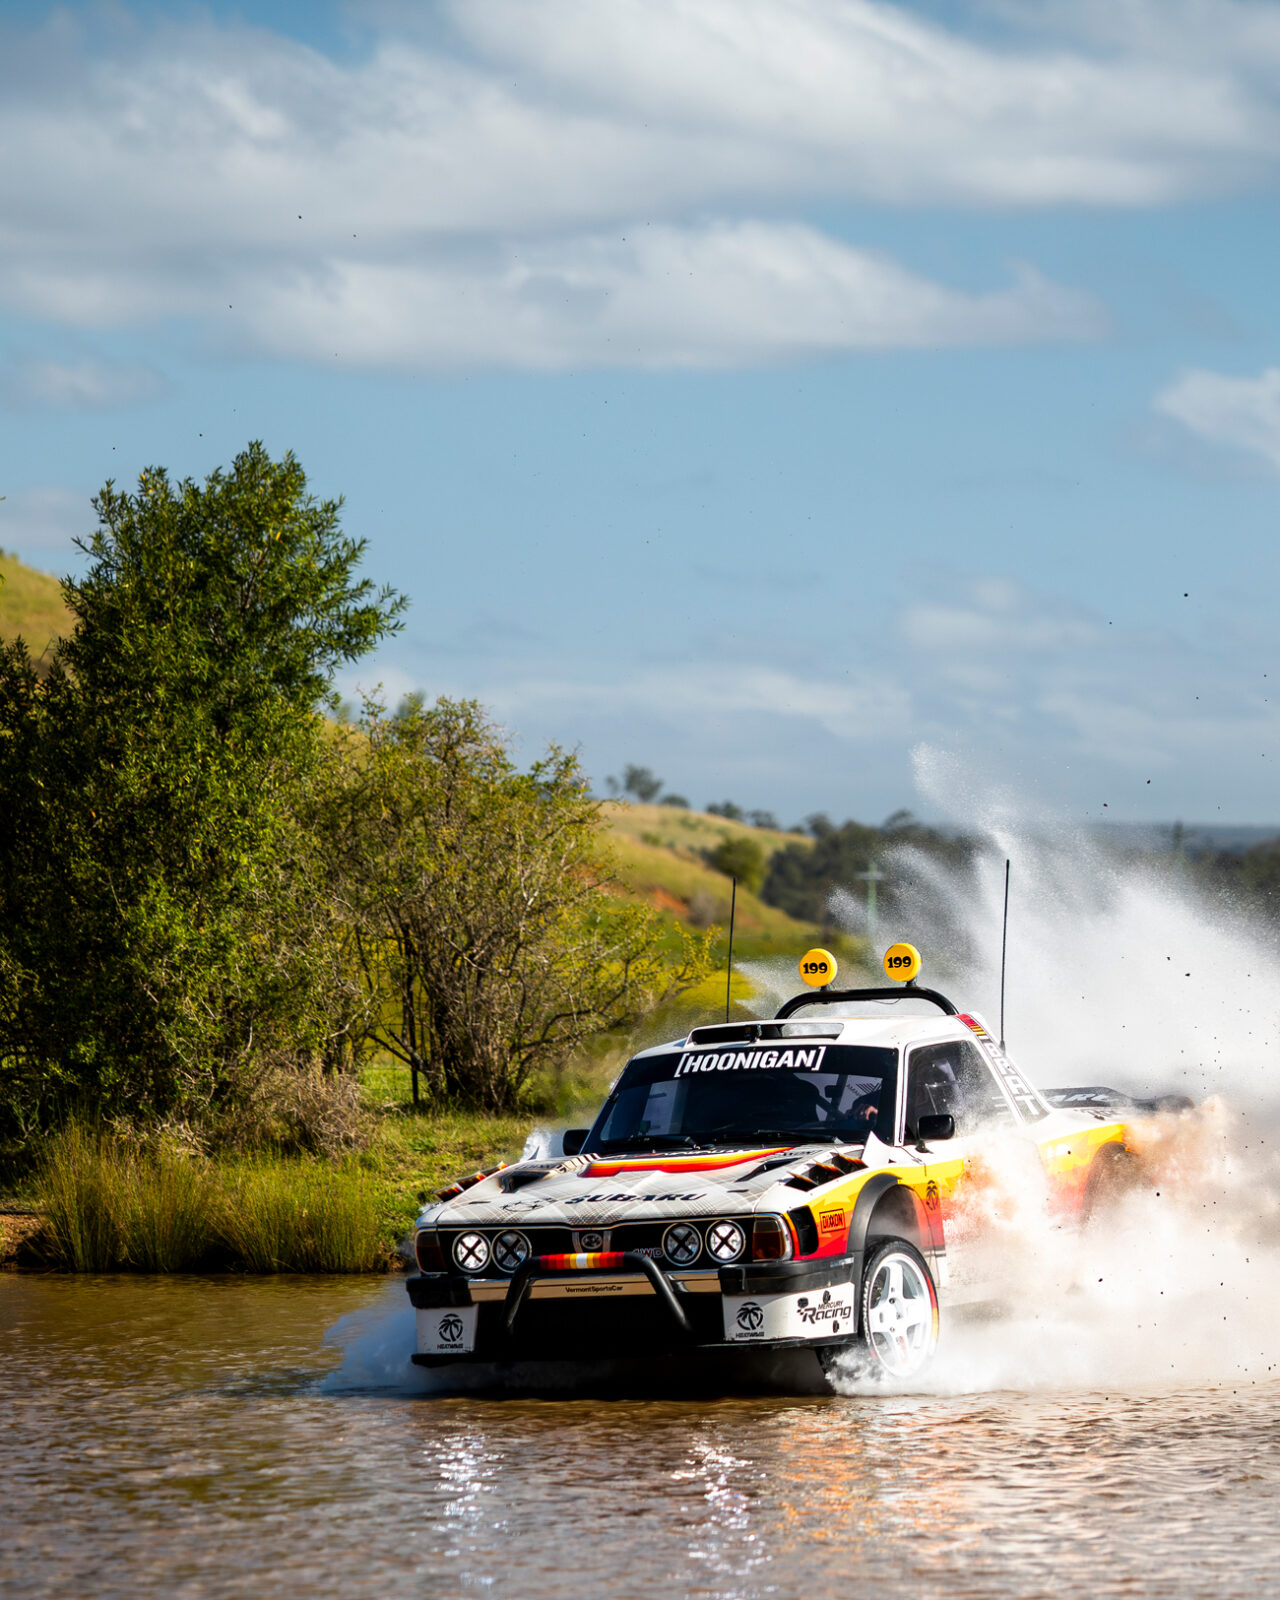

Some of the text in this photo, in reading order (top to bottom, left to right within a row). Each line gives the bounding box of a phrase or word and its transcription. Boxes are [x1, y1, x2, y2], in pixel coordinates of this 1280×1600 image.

[803, 962, 828, 974] 199
[888, 956, 912, 968] 199
[984, 1042, 1040, 1116] BRAT
[565, 1193, 707, 1204] SUBARU
[822, 1212, 844, 1229] DIXXON
[818, 1300, 843, 1310] MERCURY
[802, 1306, 852, 1324] Racing
